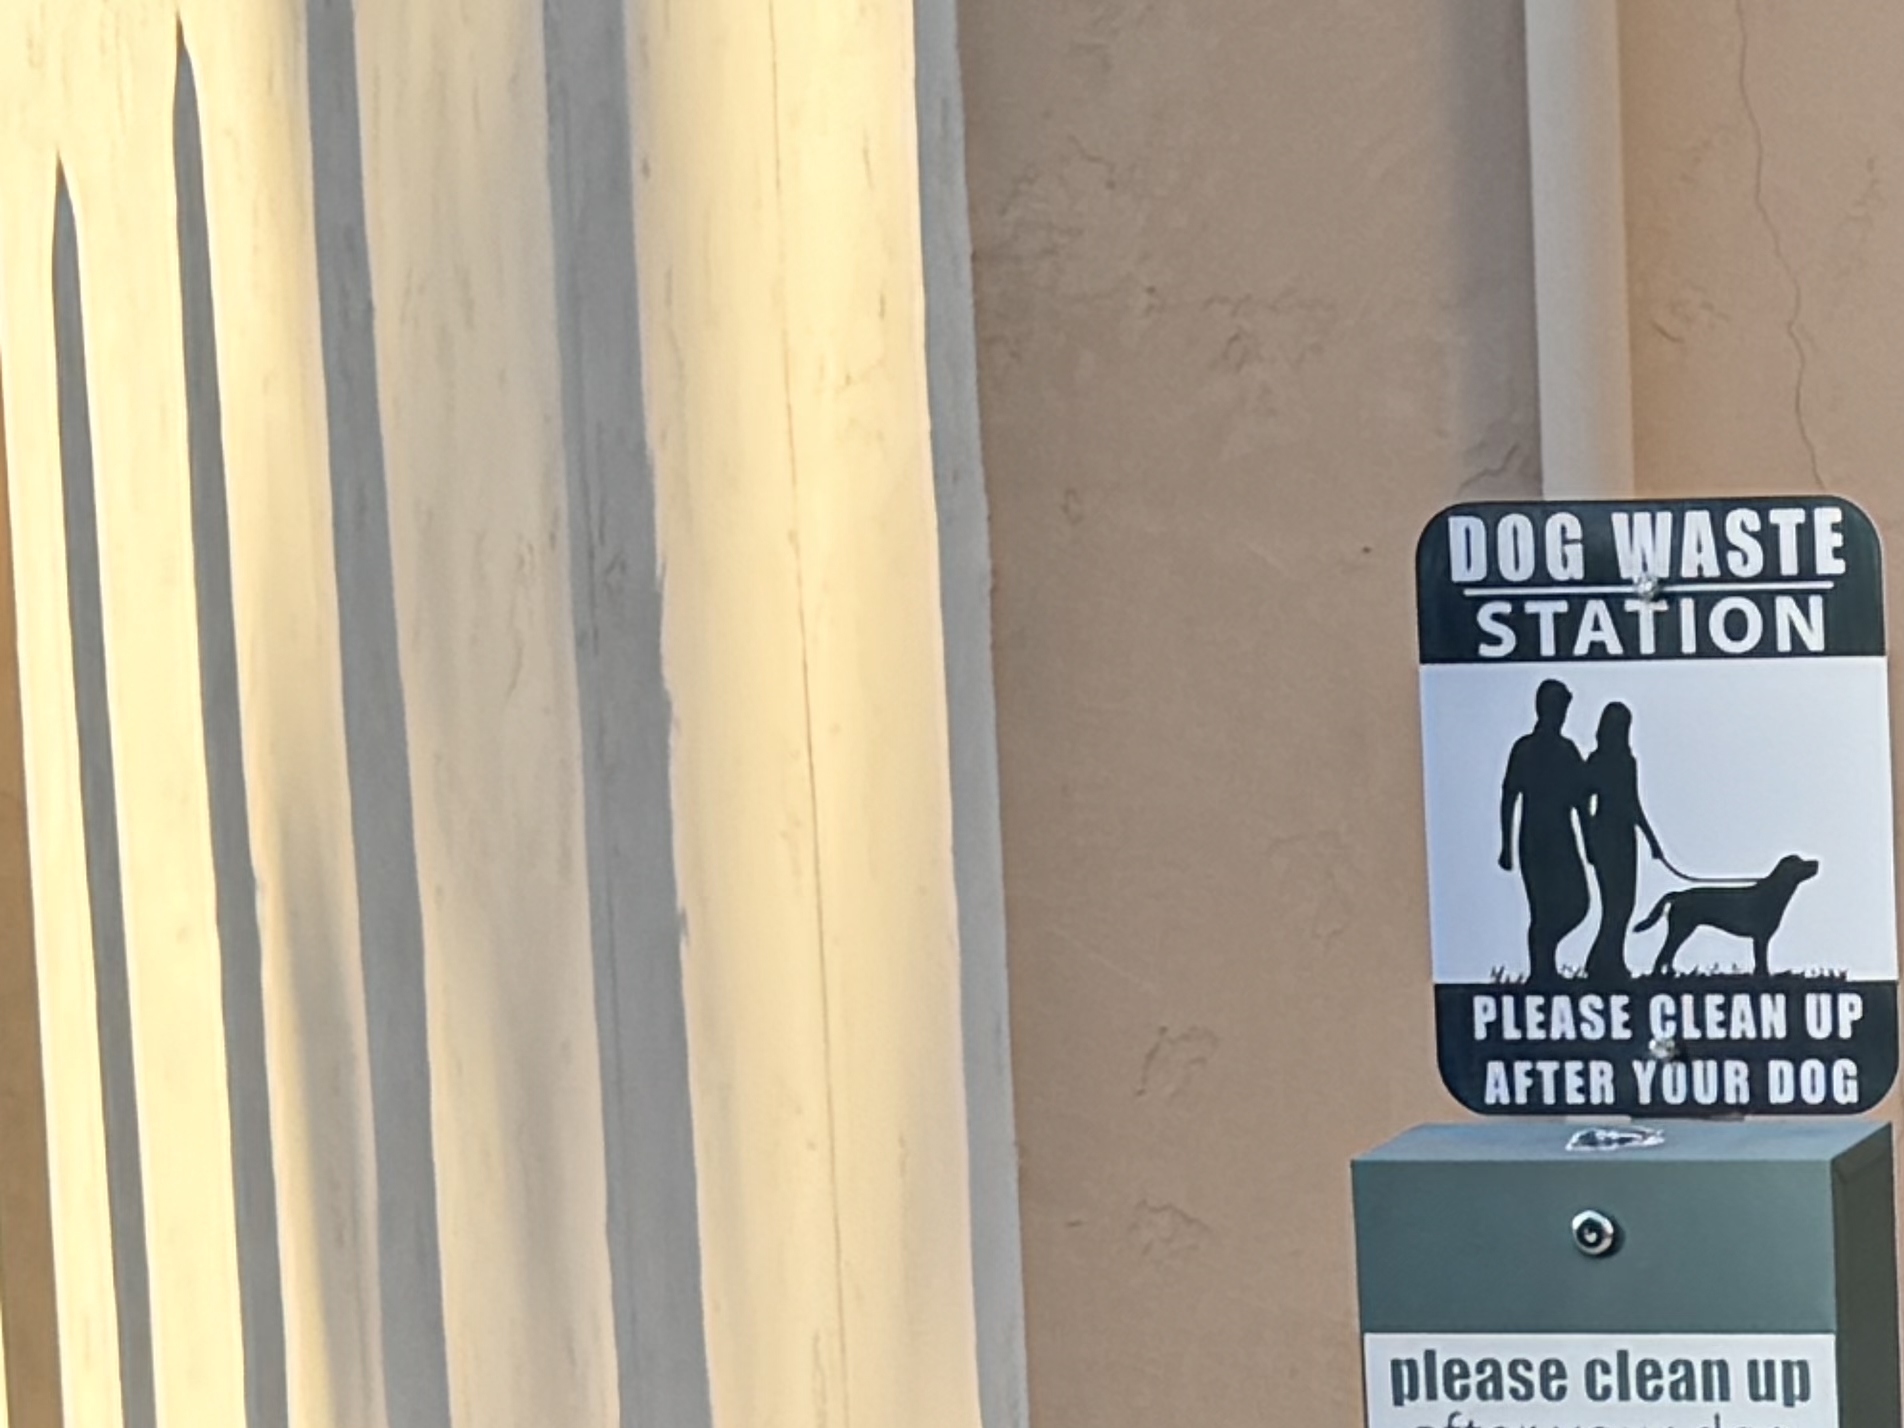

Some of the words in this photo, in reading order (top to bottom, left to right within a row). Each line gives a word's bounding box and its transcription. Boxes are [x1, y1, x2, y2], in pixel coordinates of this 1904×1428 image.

[1449, 513, 1585, 583] DOG
[1611, 507, 1847, 580] WASTE
[1476, 595, 1826, 657] STATION
[1473, 995, 1633, 1041] PLEASE
[1649, 994, 1787, 1040] CLEAN
[1805, 993, 1864, 1040] UP
[1484, 1060, 1616, 1105] AFTER
[1632, 1058, 1751, 1105] YOUR
[1768, 1058, 1860, 1105] DOG
[1390, 1349, 1569, 1407] please
[1584, 1349, 1731, 1403] clean
[1747, 1358, 1812, 1408] up
